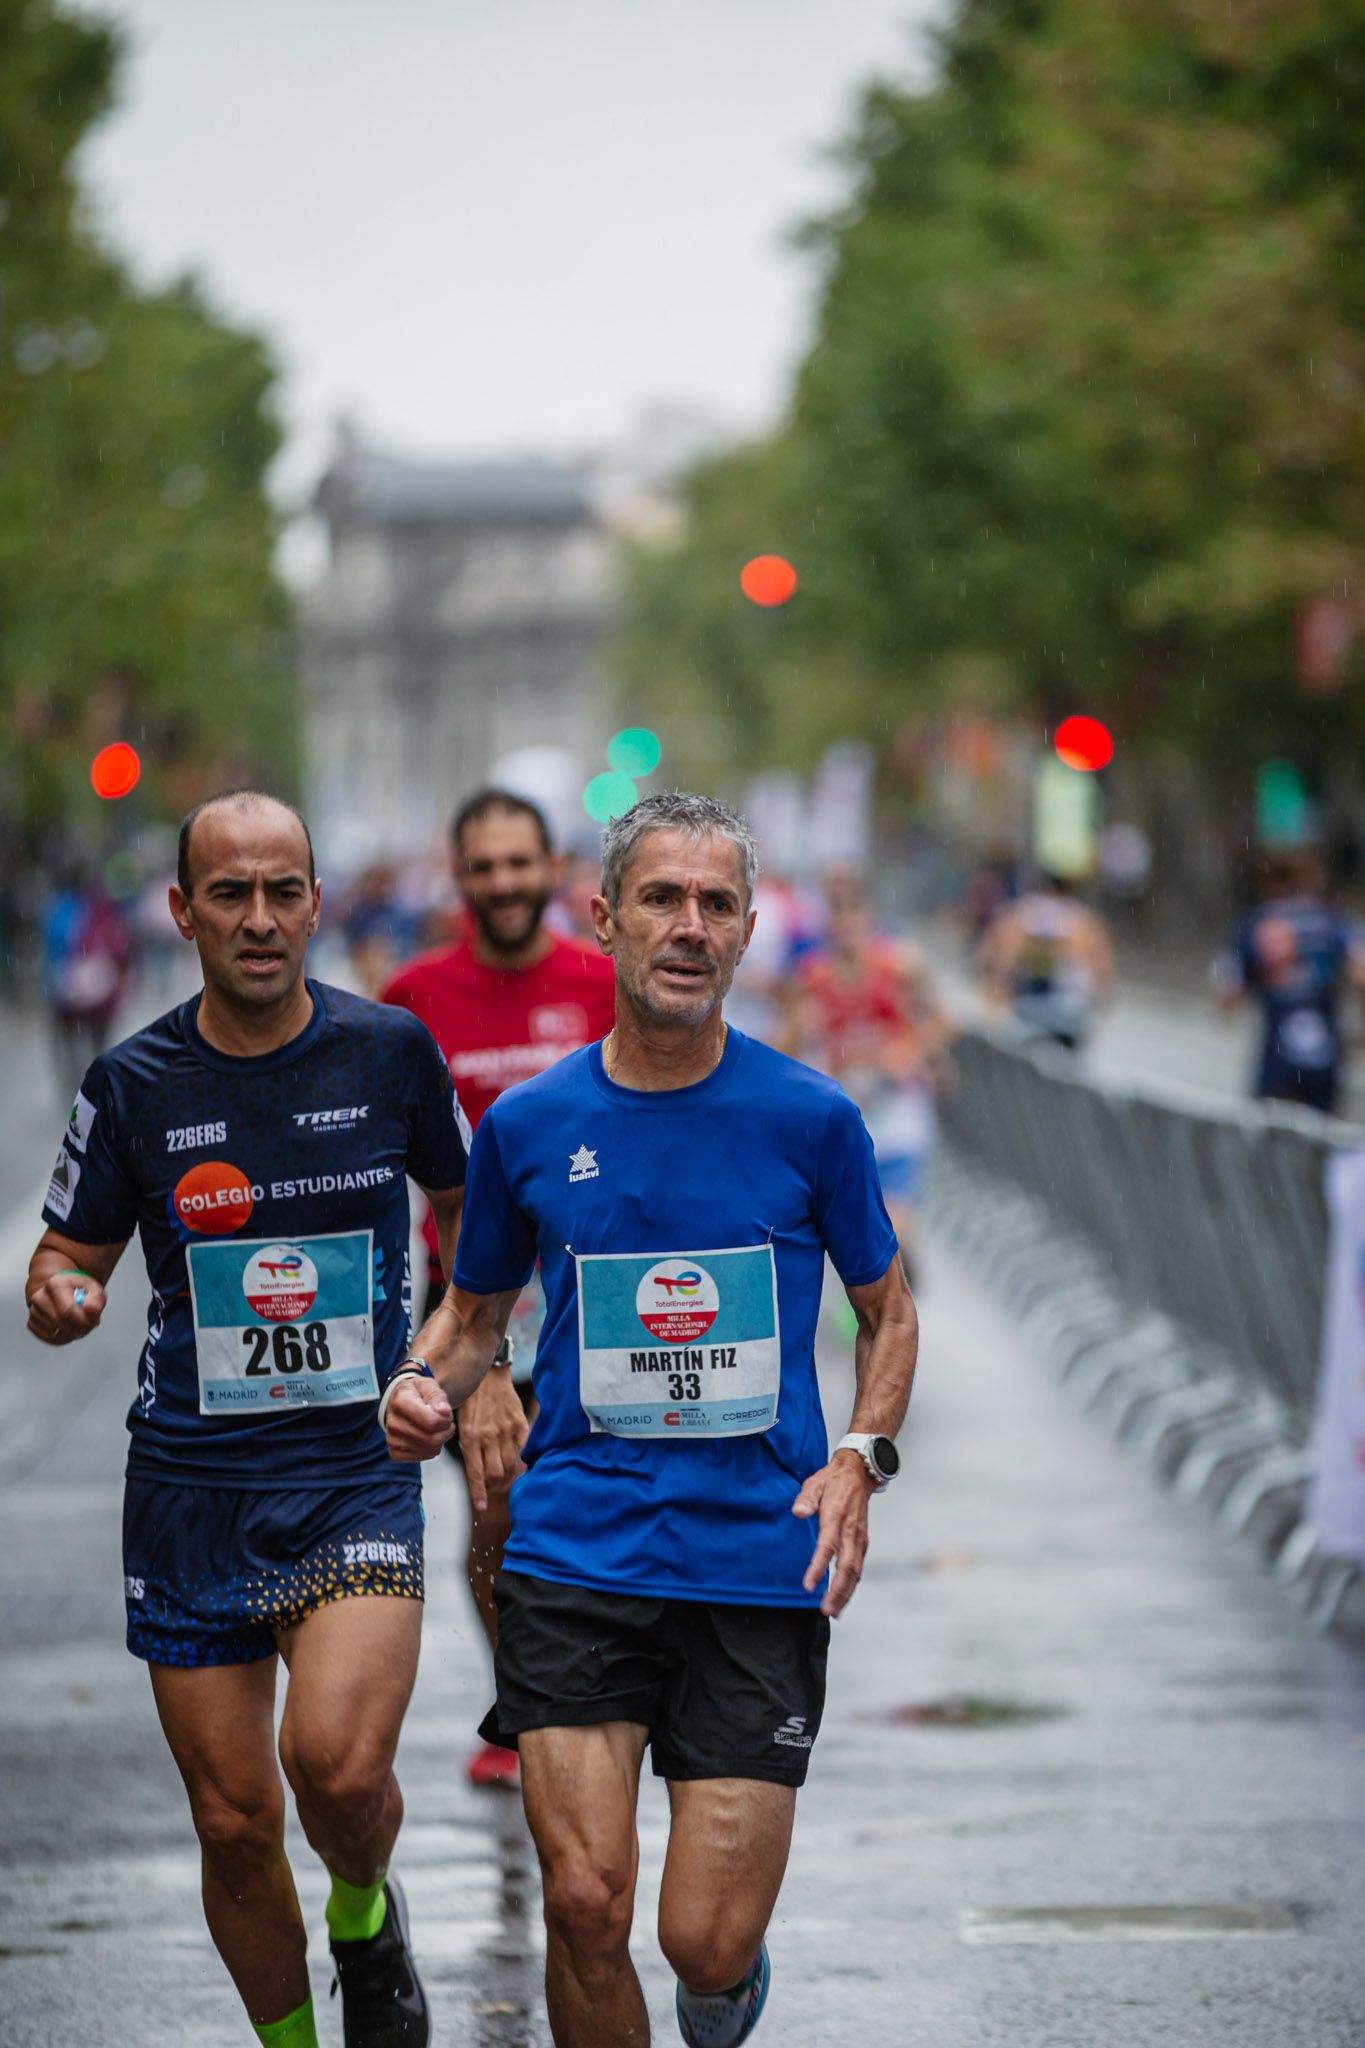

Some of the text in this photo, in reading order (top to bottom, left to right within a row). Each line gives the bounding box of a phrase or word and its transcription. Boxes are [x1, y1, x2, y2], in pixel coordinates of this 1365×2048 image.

[292, 1105, 370, 1126] TREK
[166, 1121, 227, 1153] 226ERS
[179, 1167, 394, 1214] COLEGIO ESTUDIANTES
[654, 1299, 704, 1308] TotalEnergies
[671, 1329, 700, 1337] MADRID
[243, 1322, 332, 1377] 268
[630, 1347, 737, 1373] MARTÍN FIZ
[219, 1389, 258, 1401] MADRID
[667, 1373, 701, 1401] 33
[607, 1414, 653, 1426] MADRID
[342, 1541, 408, 1565] 226ERS
